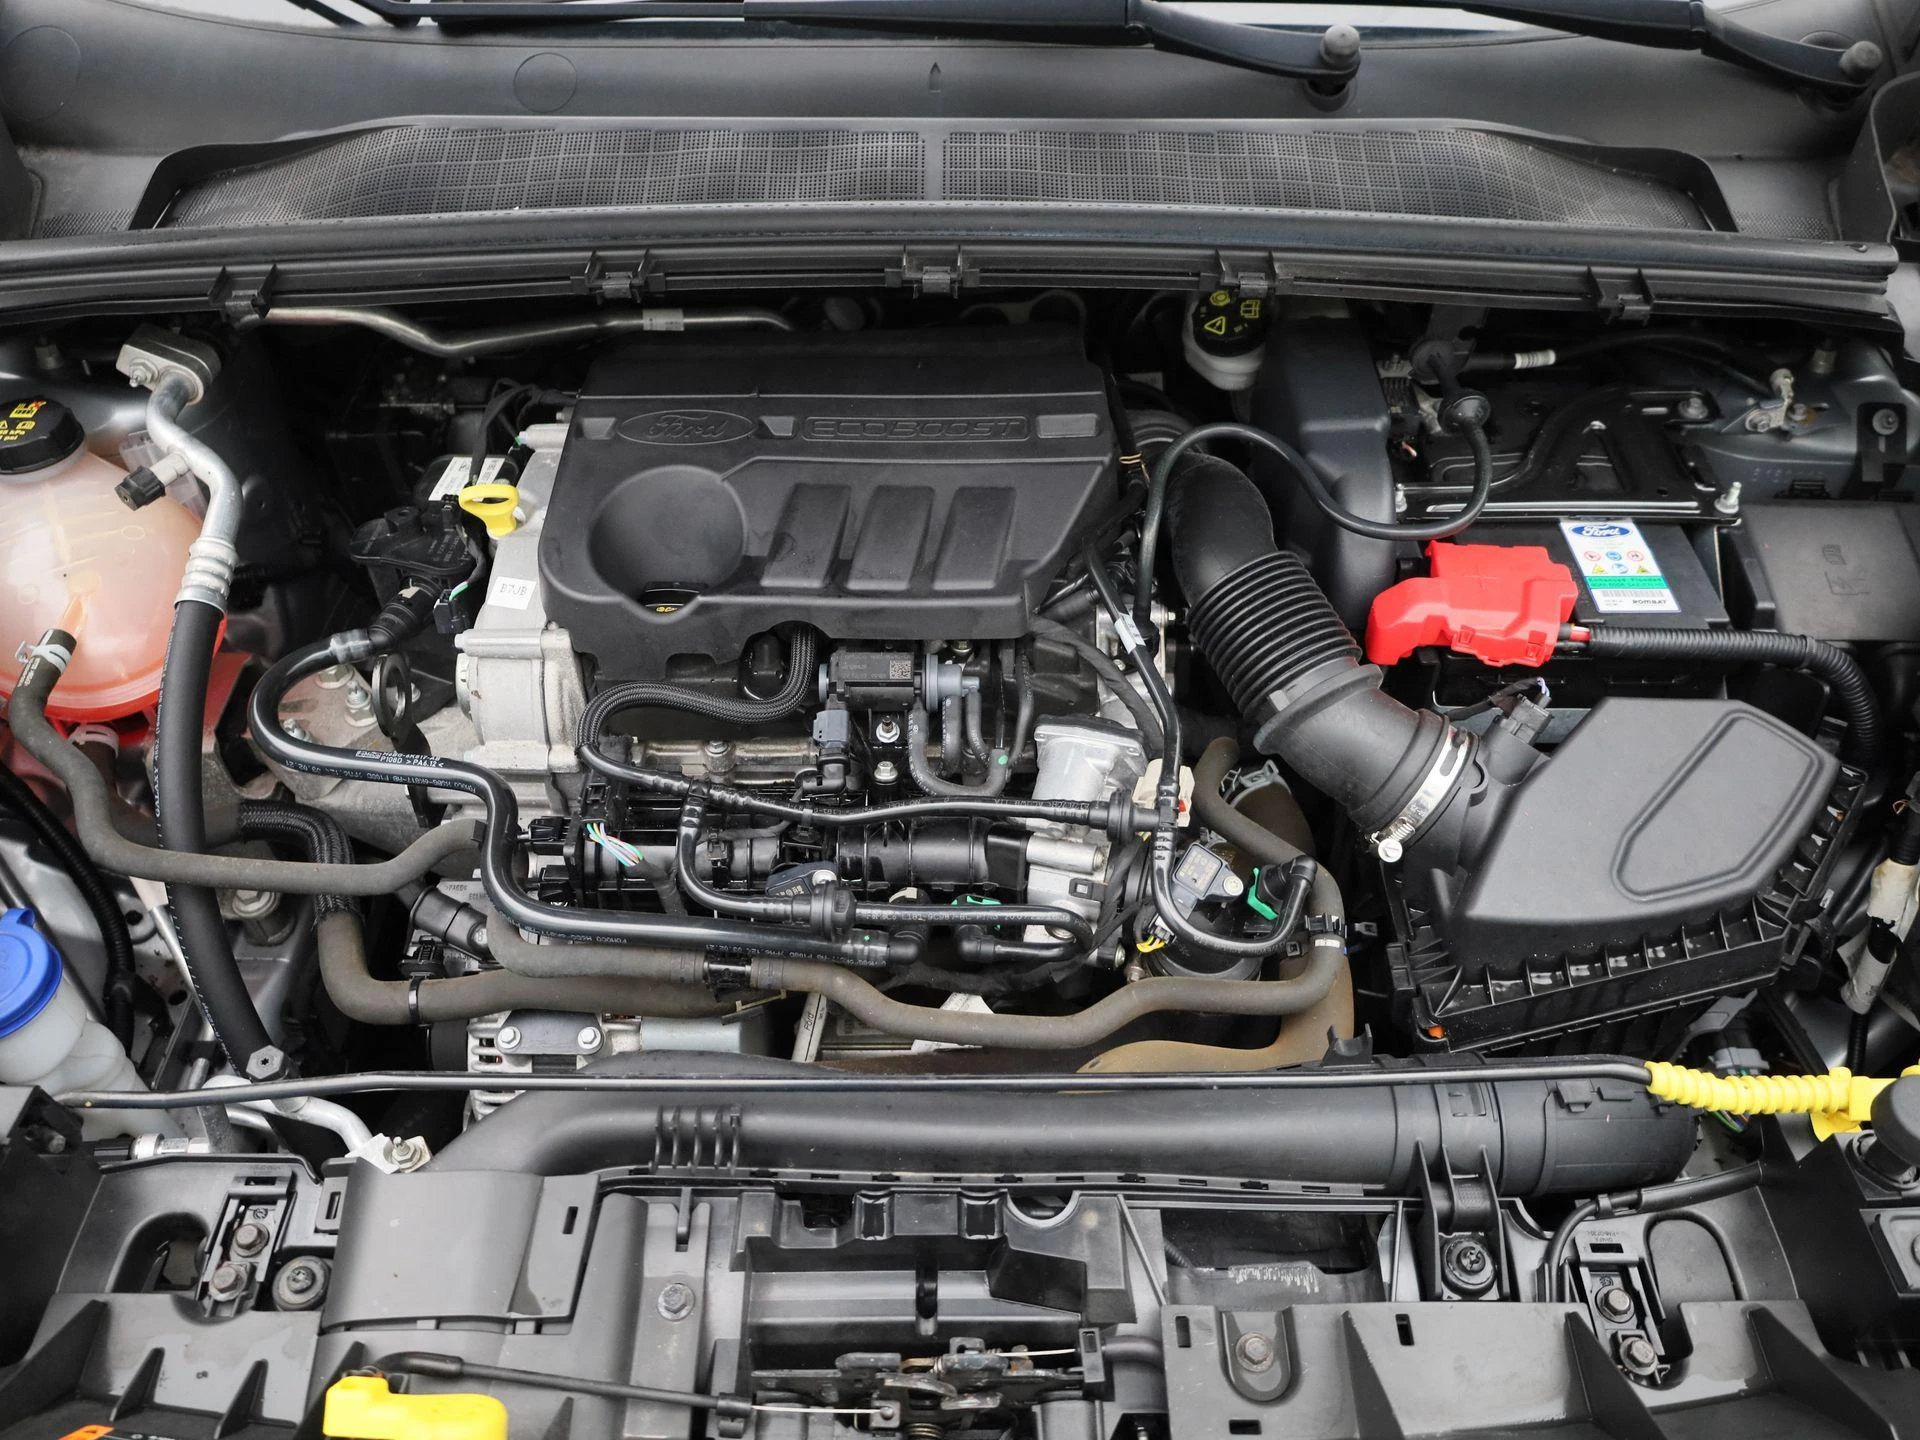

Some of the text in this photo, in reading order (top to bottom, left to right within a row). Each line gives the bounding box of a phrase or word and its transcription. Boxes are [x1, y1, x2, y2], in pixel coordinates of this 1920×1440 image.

[648, 414, 728, 438] Ford
[1581, 523, 1620, 537] Ford
[500, 583, 528, 596] B7JB
[153, 766, 161, 818] GALAXY
